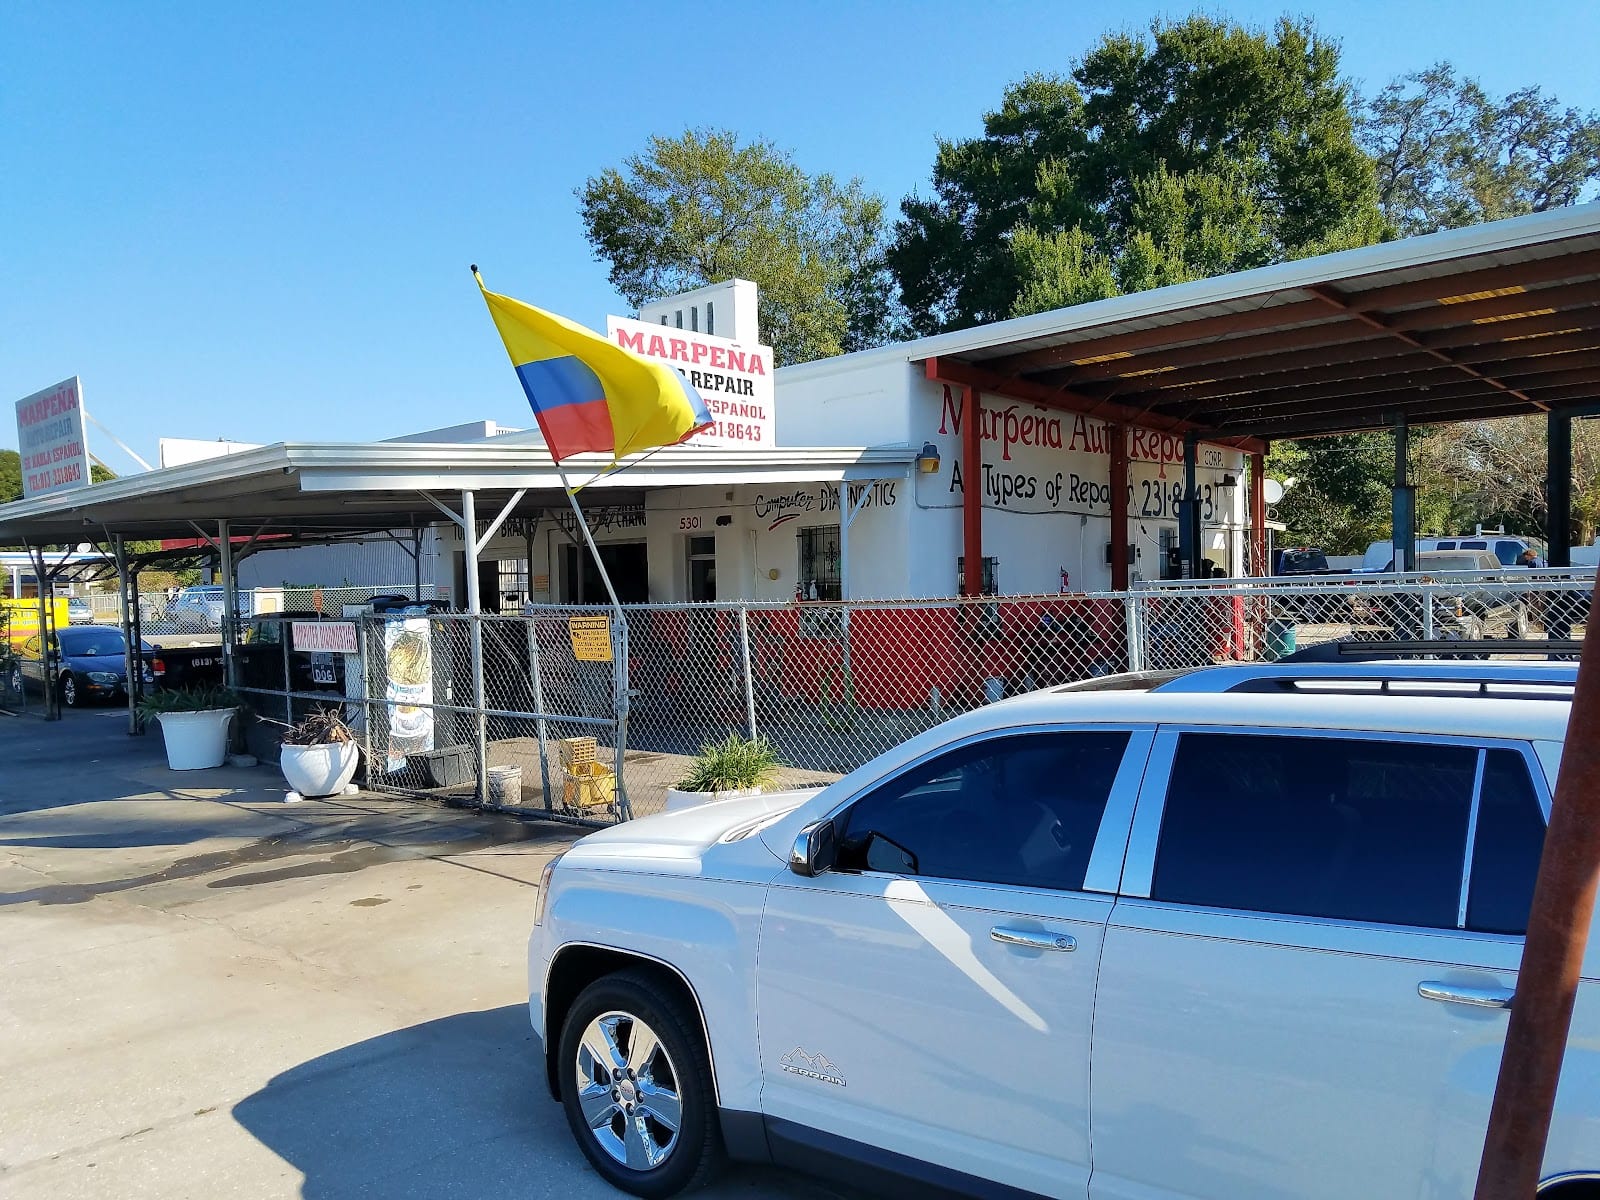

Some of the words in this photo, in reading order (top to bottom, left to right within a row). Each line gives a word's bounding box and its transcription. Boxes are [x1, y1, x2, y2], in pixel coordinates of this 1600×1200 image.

[617, 328, 765, 376] MARPEÑA
[690, 370, 754, 396] REPAIR
[19, 386, 76, 426] MARPEÑA
[704, 399, 766, 420] ESPAÑOL
[1069, 414, 1122, 455] Aut
[1204, 450, 1223, 467] CORP.
[820, 482, 896, 511] DIANOSTICS
[982, 464, 1037, 505] Types
[1046, 473, 1062, 507] of
[679, 516, 702, 529] 5301
[571, 621, 606, 629] WARNING
[315, 669, 333, 681] DOG
[780, 1063, 847, 1087] TERRAIN
